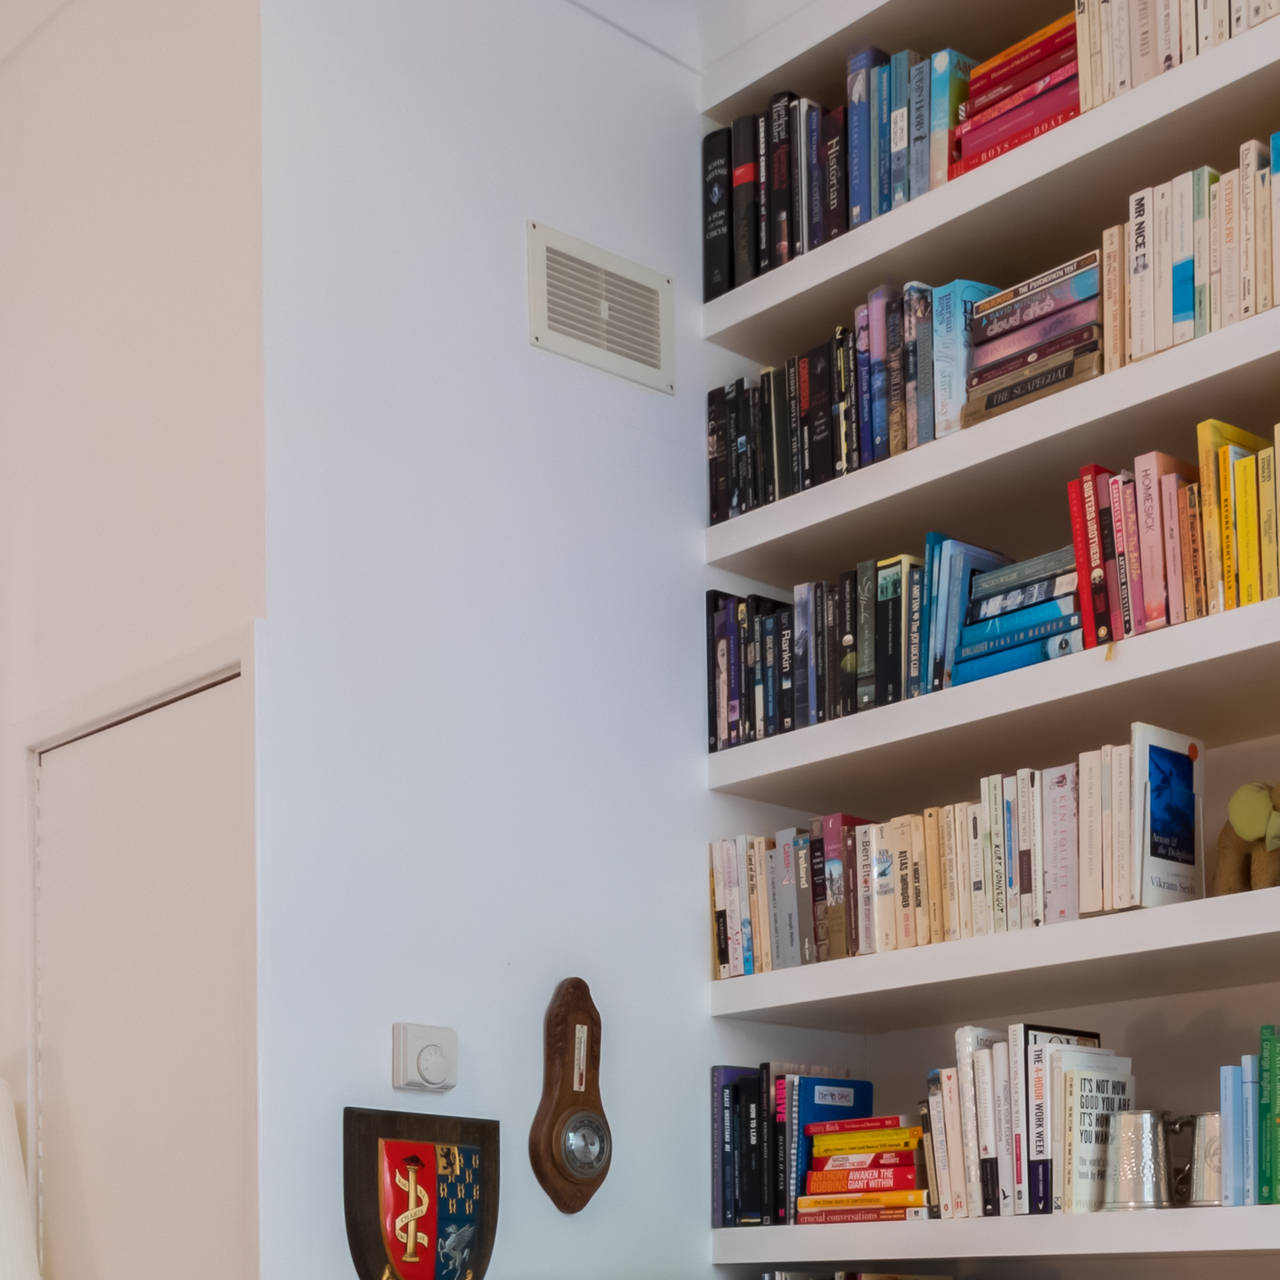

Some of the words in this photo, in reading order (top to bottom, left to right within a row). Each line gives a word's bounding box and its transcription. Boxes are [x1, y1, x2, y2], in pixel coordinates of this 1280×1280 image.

[827, 136, 840, 210] Historian
[1135, 197, 1145, 218] MR
[1135, 221, 1146, 252] NICE
[993, 389, 1009, 405] THE
[1013, 366, 1068, 398] SCAPEGOAT
[1083, 481, 1097, 521] SISTERS
[1141, 468, 1154, 533] HOMESICK
[1087, 520, 1100, 568] BROTHERS
[988, 636, 1011, 649] PIGS
[1027, 621, 1065, 638] HEAVEN
[781, 630, 791, 672] Rankin
[798, 850, 809, 889] Ireland
[994, 869, 1004, 913] VONNEGUT
[1034, 1049, 1043, 1064] THE
[1034, 1066, 1044, 1100] 4-HOUR
[1080, 1078, 1093, 1093] IT'S
[1095, 1079, 1109, 1094] NOT
[1112, 1080, 1127, 1096] HOW
[775, 1078, 786, 1123] DRIVE
[1080, 1094, 1099, 1110] GOOD
[1102, 1096, 1115, 1112] YOU
[1035, 1102, 1044, 1129] WORK
[1080, 1112, 1093, 1127] IT'S
[1035, 1130, 1045, 1155] WEEK
[1080, 1129, 1092, 1144] YOU
[1094, 1130, 1113, 1144] WAN
[848, 1170, 877, 1180] AWAKEN
[880, 1169, 893, 1179] THE
[848, 1179, 867, 1190] GIANT
[869, 1178, 893, 1188] WITHIN
[800, 1212, 825, 1223] crucial
[827, 1209, 878, 1222] conversations
